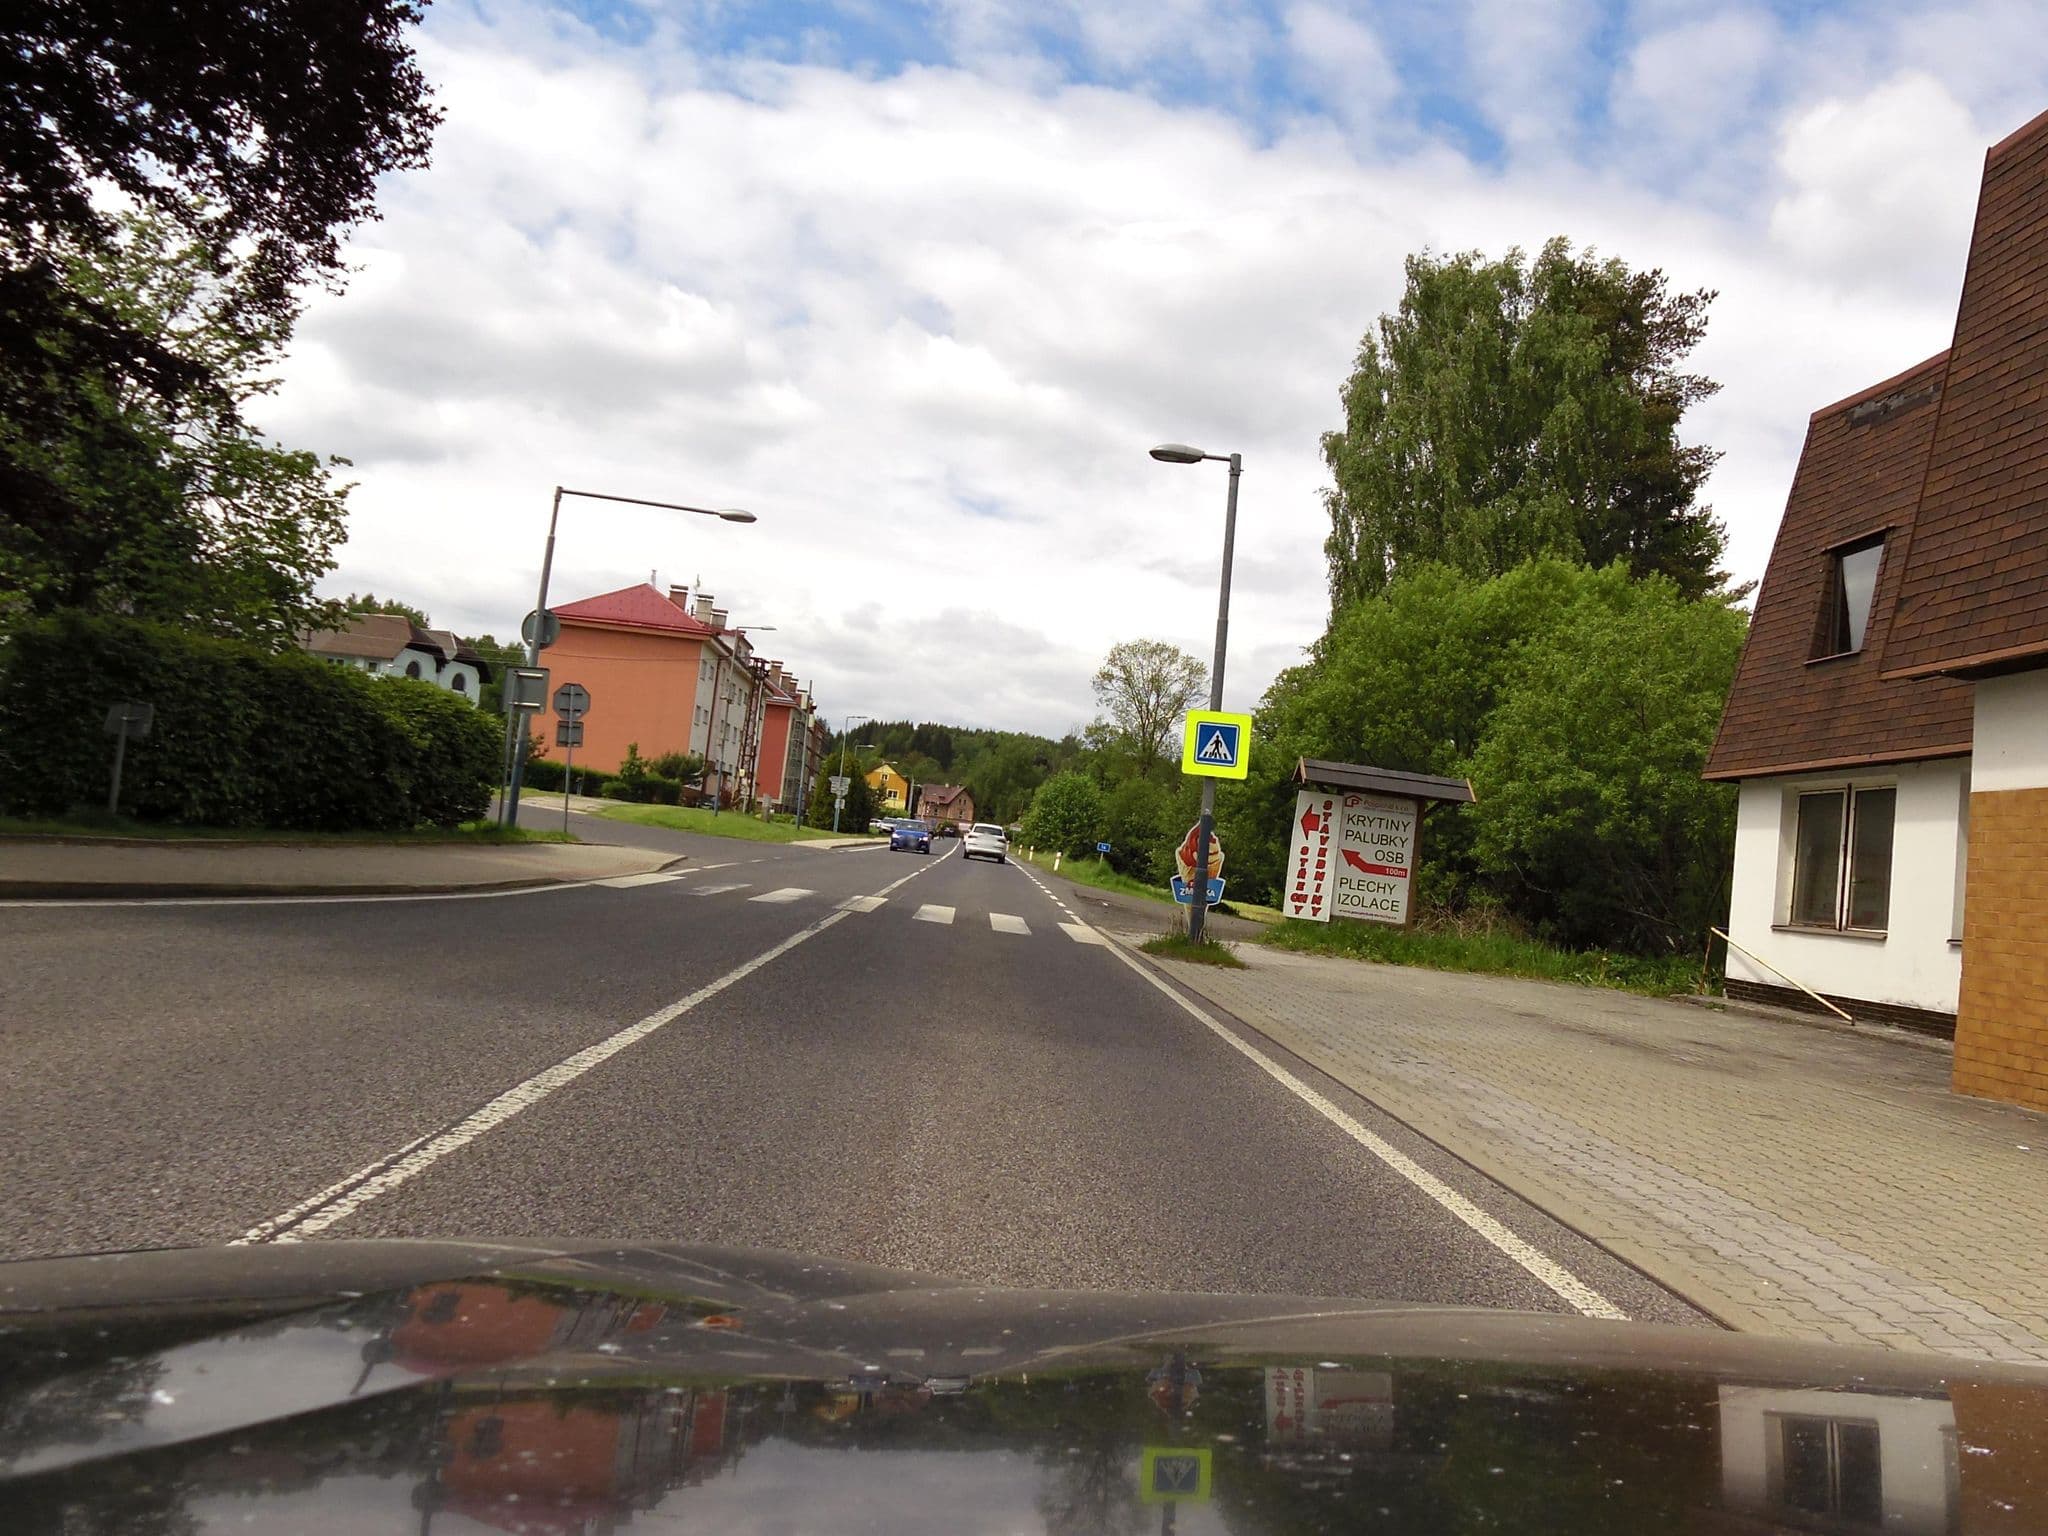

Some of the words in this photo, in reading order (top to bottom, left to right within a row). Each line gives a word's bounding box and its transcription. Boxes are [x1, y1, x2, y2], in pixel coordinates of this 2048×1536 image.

[1346, 813, 1412, 833] KRYTINY
[1345, 829, 1409, 848] PALUBKY
[1374, 849, 1405, 864] OSB
[1385, 867, 1406, 877] 100m
[1339, 877, 1397, 895] PLECHY
[1337, 893, 1400, 912] IZOLACE
